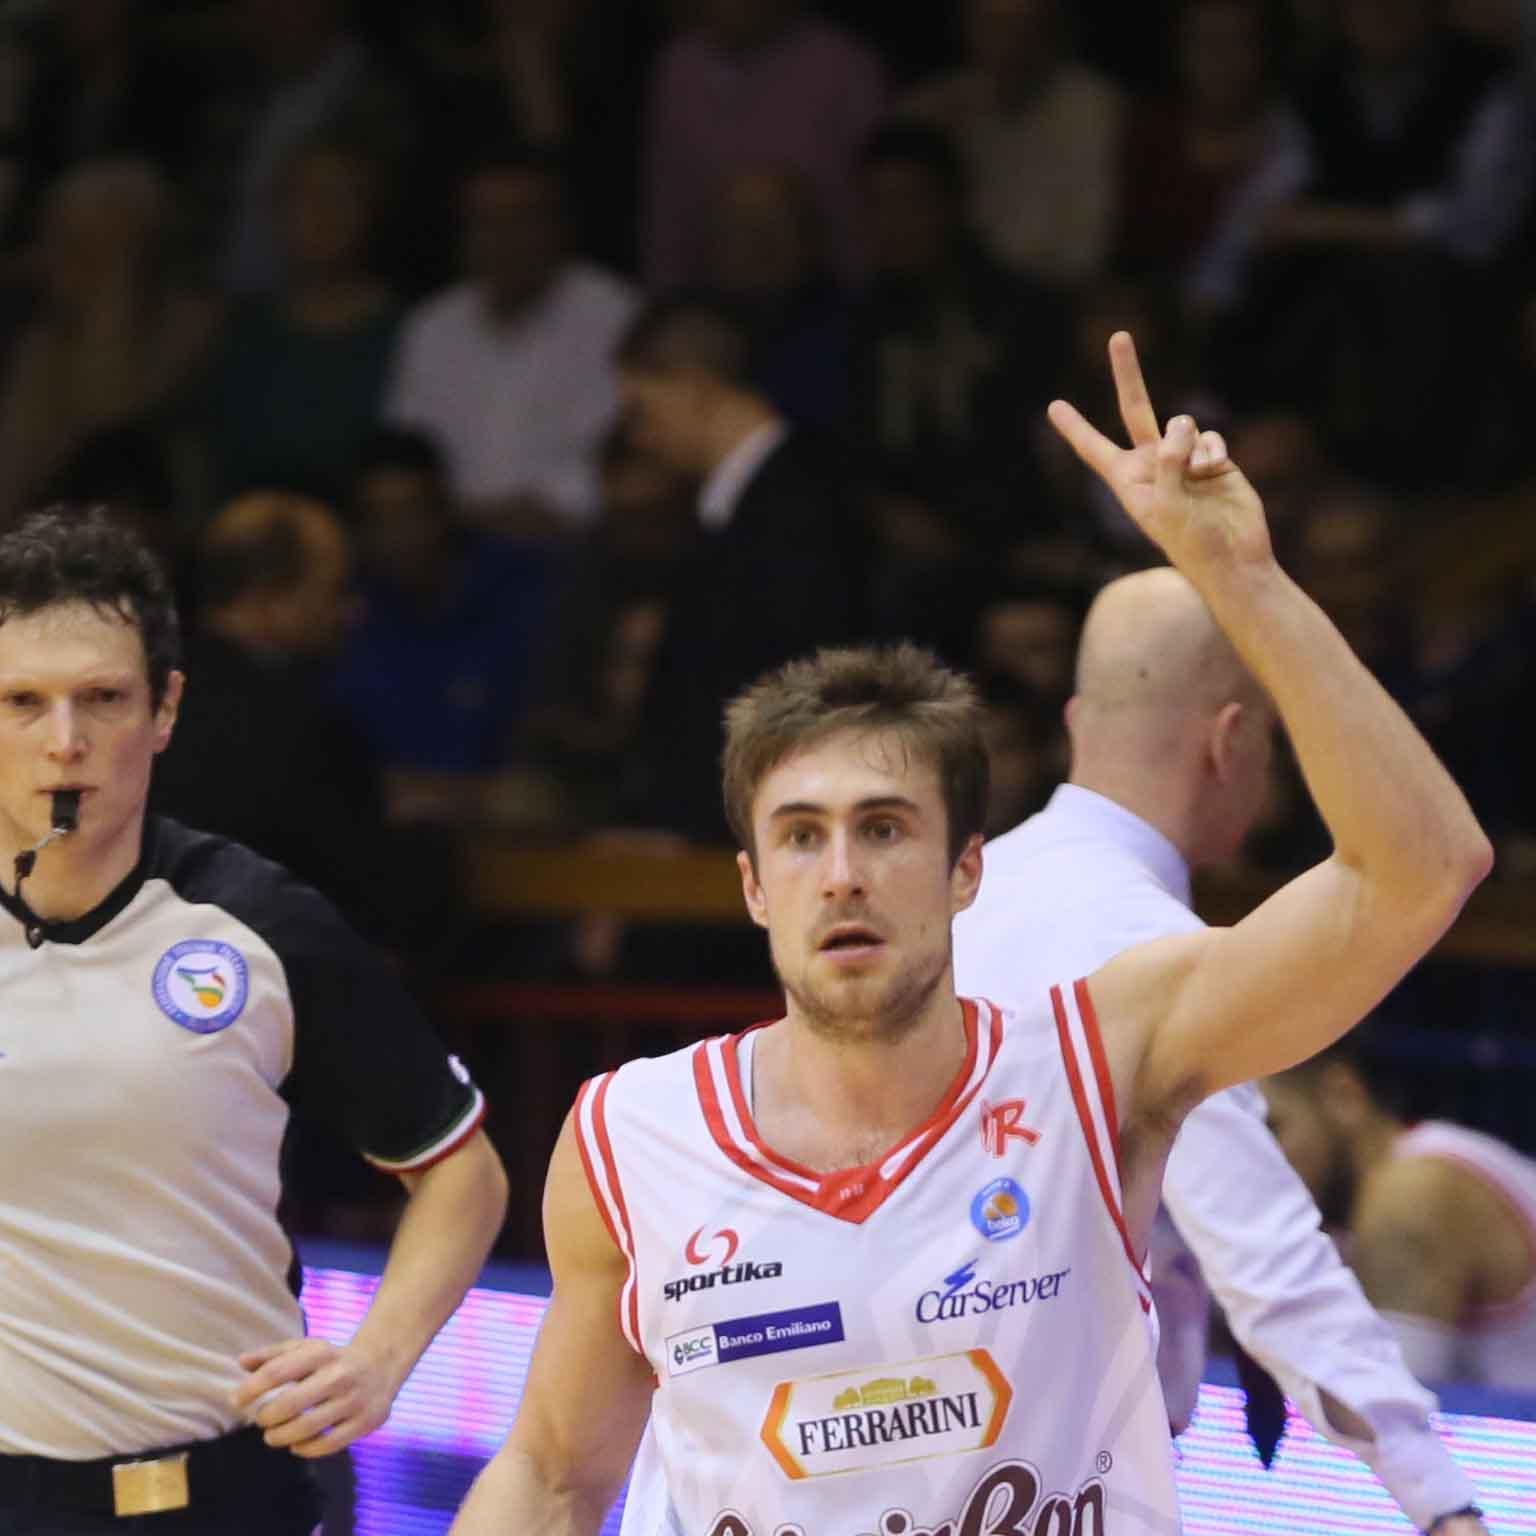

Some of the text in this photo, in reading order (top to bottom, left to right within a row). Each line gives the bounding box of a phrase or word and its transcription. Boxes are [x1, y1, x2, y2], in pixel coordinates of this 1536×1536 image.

[664, 1261, 783, 1302] sportika
[718, 1332, 763, 1350] Banco
[765, 1319, 832, 1341] Emiliano
[797, 1391, 984, 1456] FERRARINI
